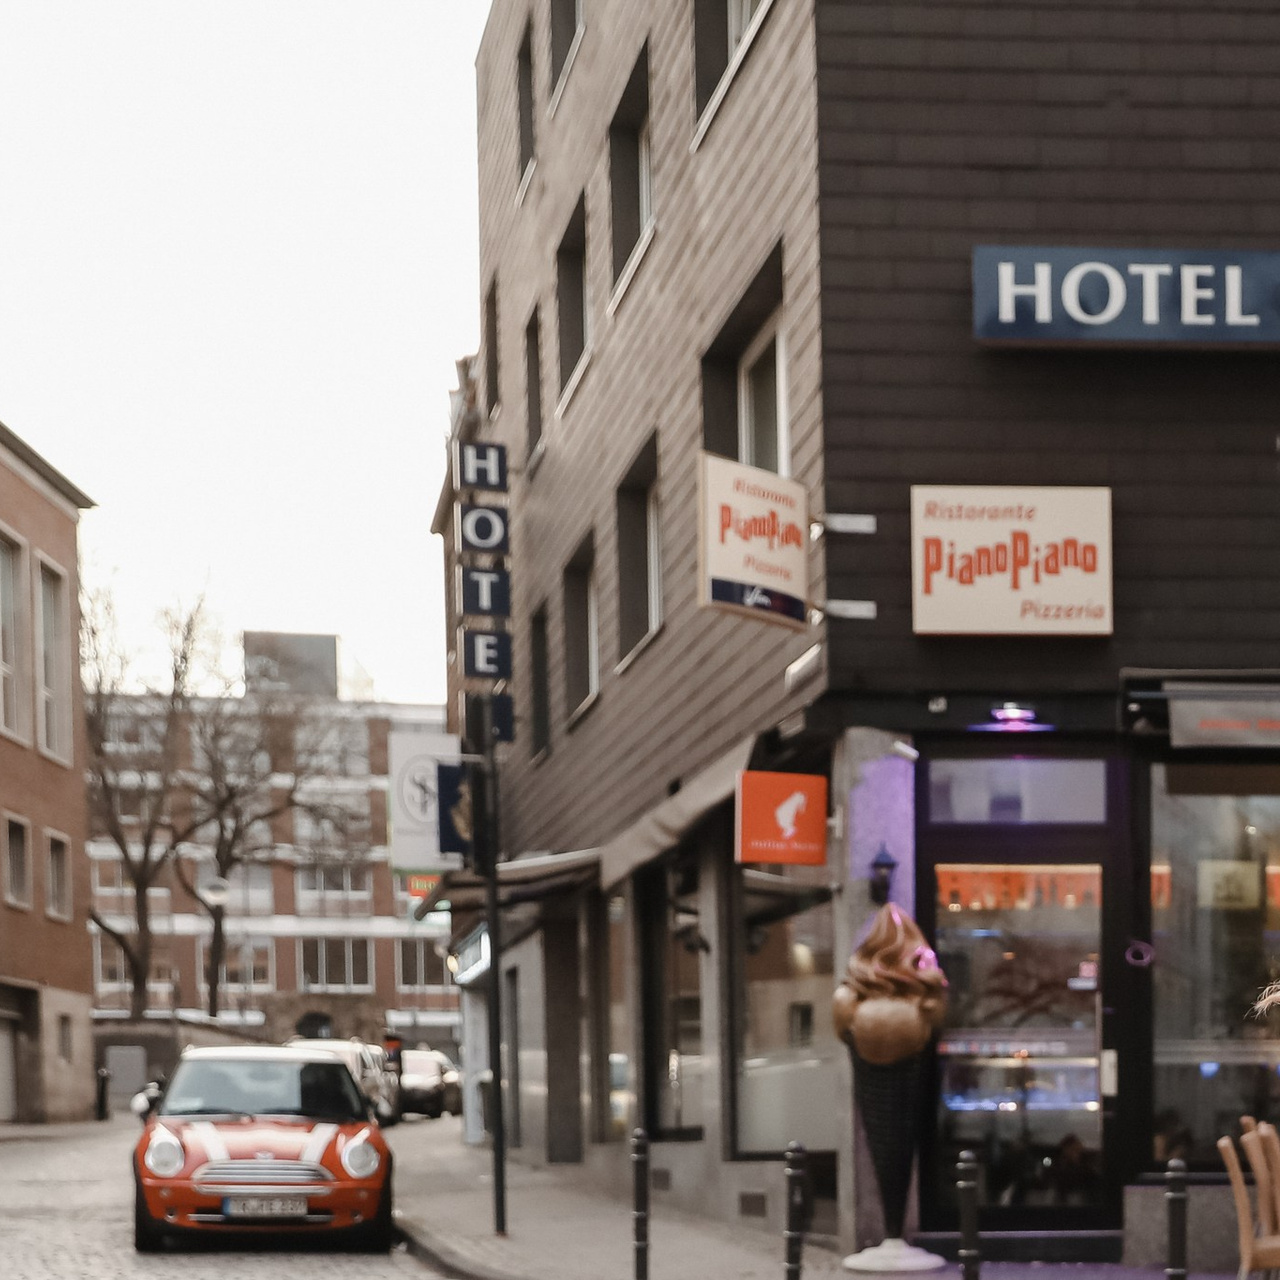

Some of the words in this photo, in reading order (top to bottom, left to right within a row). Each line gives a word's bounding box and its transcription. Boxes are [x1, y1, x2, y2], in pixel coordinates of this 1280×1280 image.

[997, 261, 1260, 328] HOTEL
[923, 500, 1037, 522] Ristorante
[462, 444, 511, 735] HOTE
[922, 530, 1098, 596] PianoPiano
[1020, 599, 1106, 621] Pizzeria
